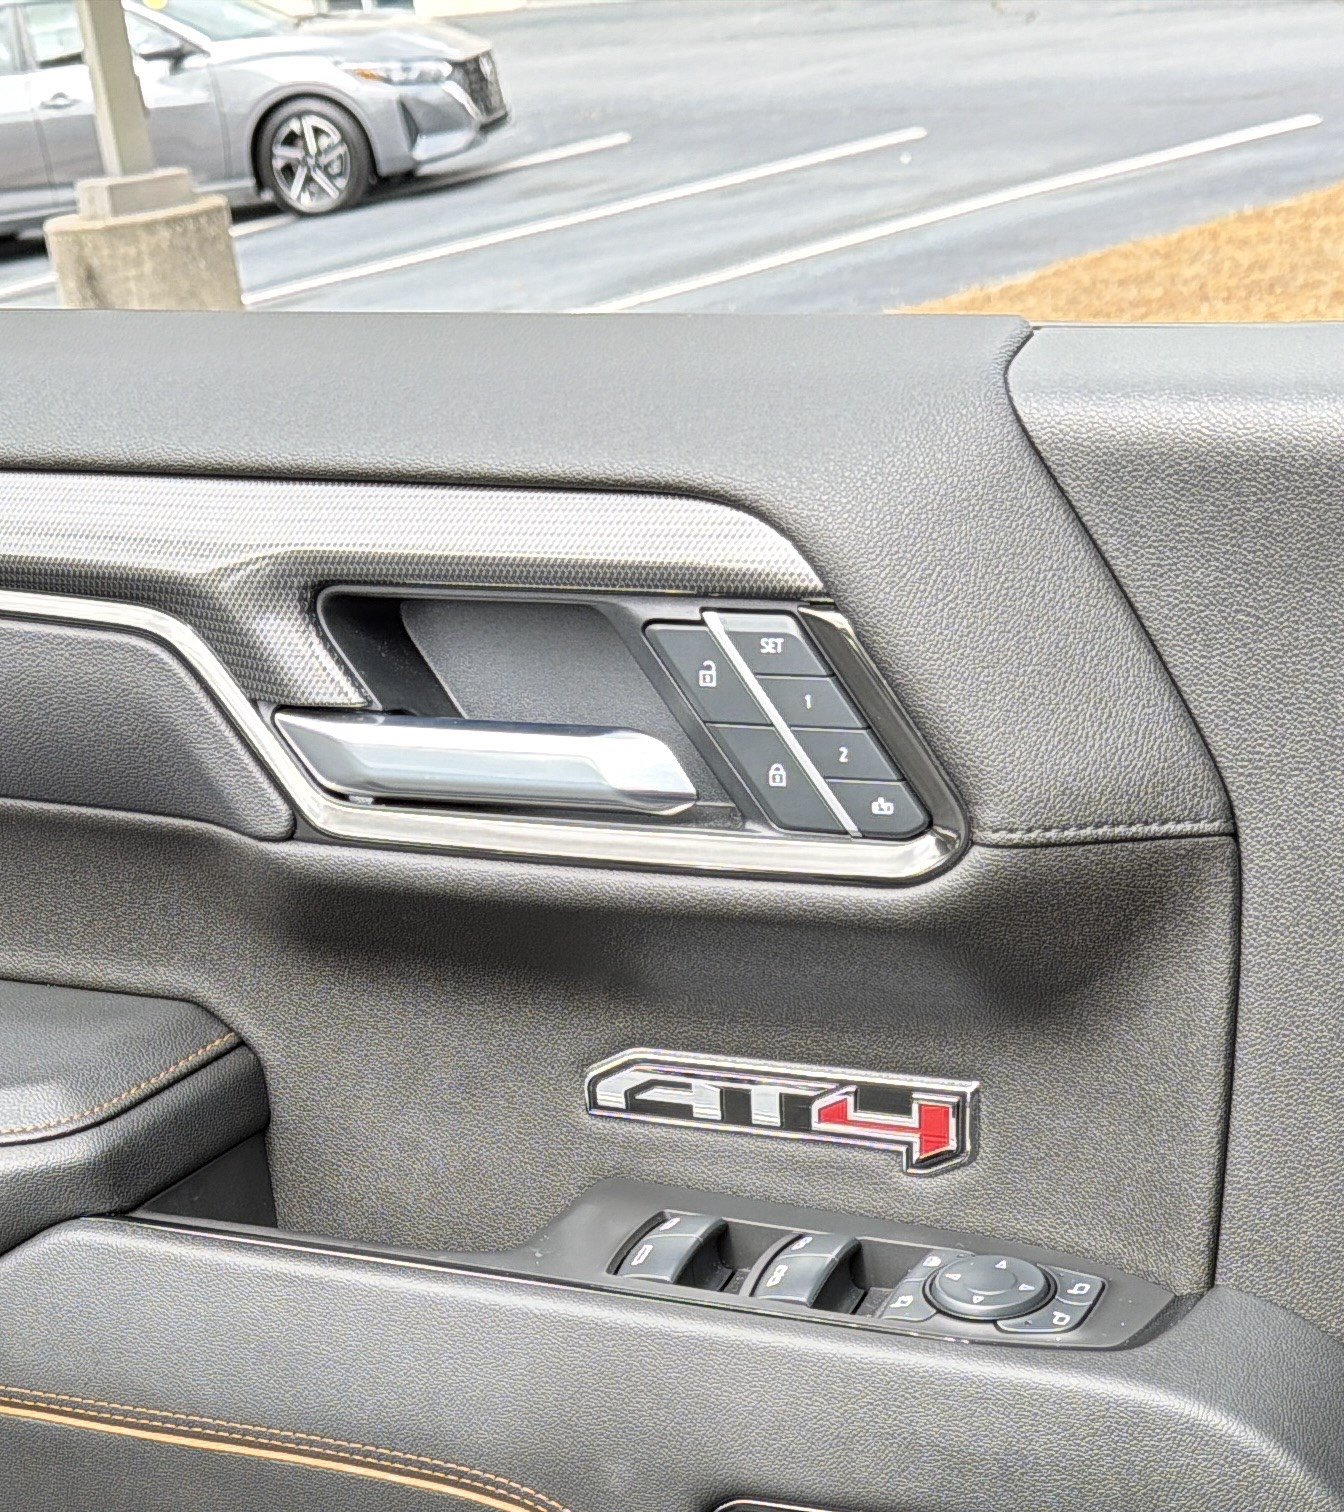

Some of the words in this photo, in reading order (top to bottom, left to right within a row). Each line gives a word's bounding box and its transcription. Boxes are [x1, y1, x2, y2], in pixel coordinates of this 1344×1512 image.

[760, 637, 785, 654] SET
[805, 694, 812, 710] 1
[838, 746, 849, 763] 2
[595, 1063, 958, 1166] AT4
